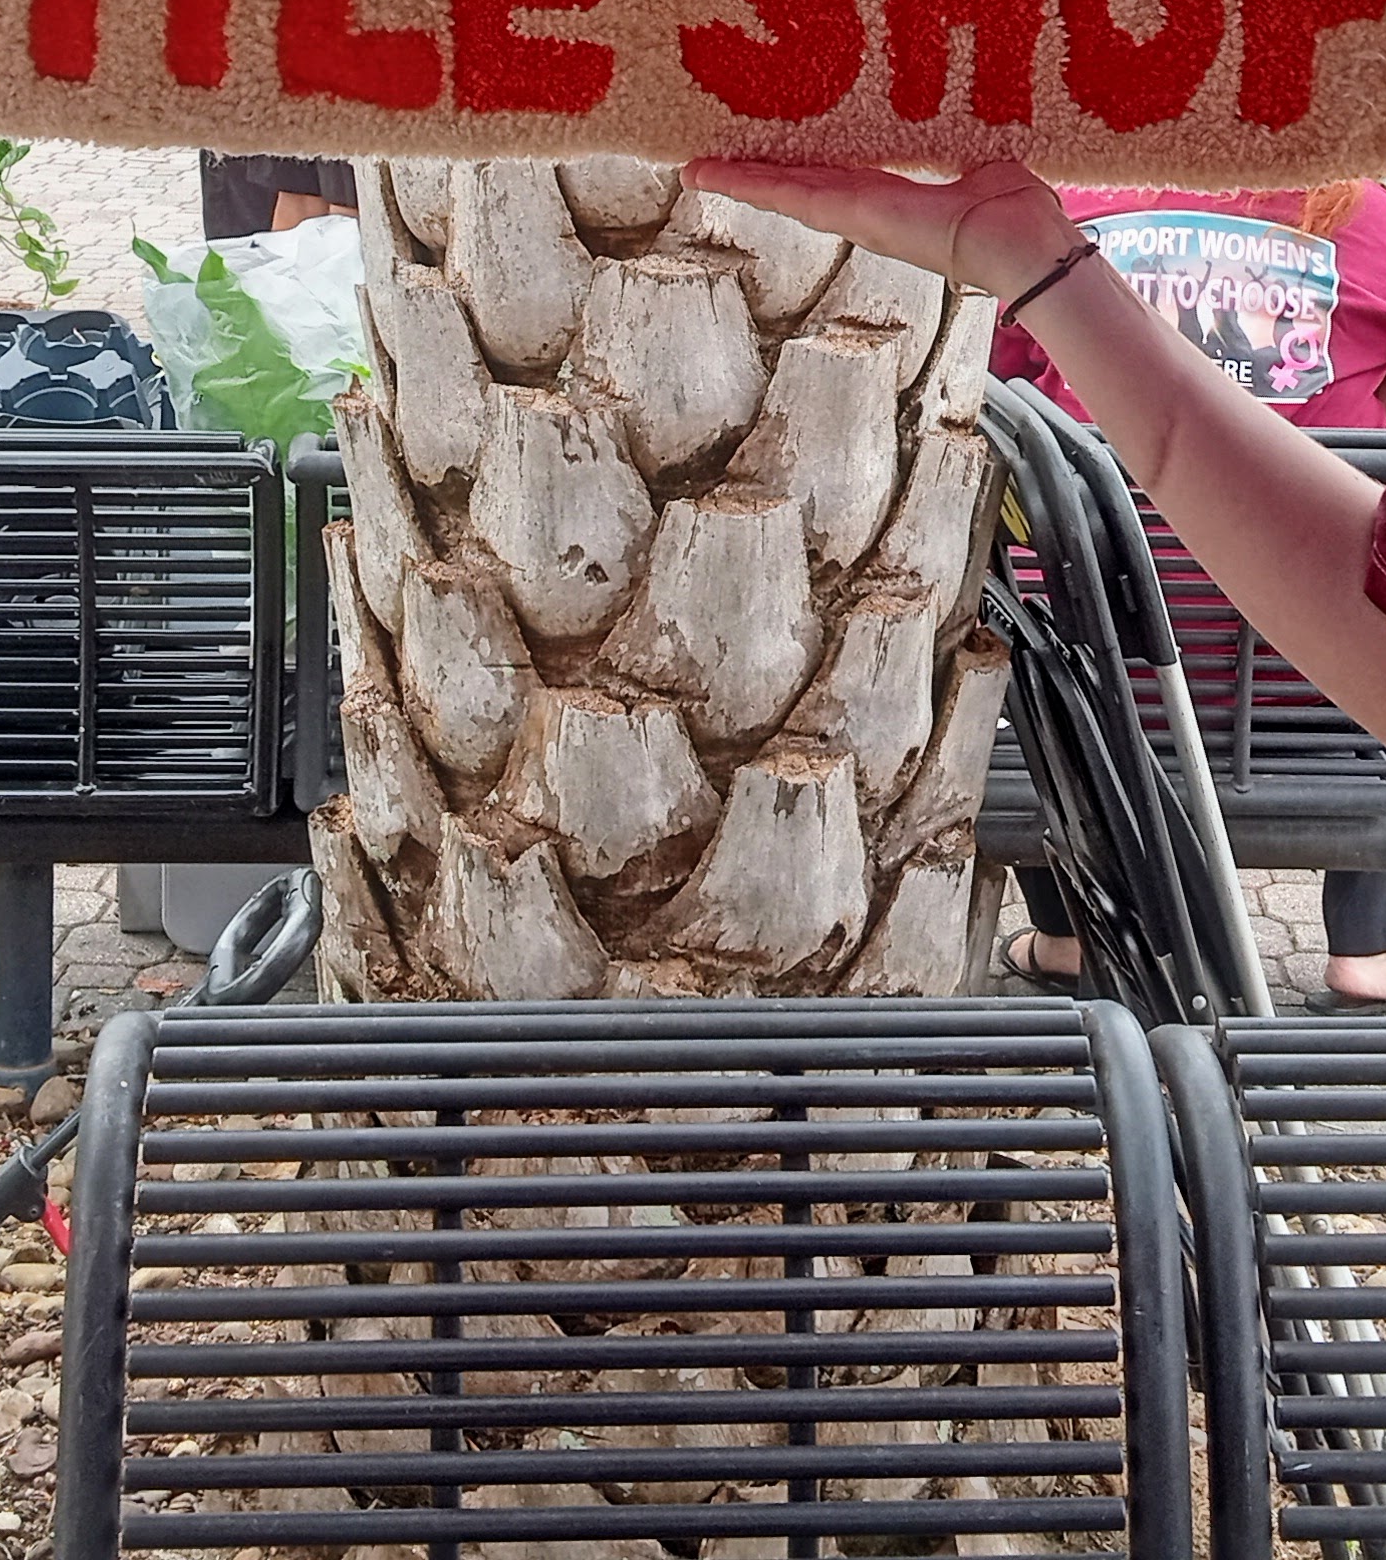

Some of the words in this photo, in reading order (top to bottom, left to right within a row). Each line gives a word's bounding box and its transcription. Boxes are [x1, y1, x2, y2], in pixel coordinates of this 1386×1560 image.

[1197, 229, 1328, 277] WOMEN'S
[1157, 273, 1199, 309] TO
[1204, 278, 1319, 320] CHOOSE
